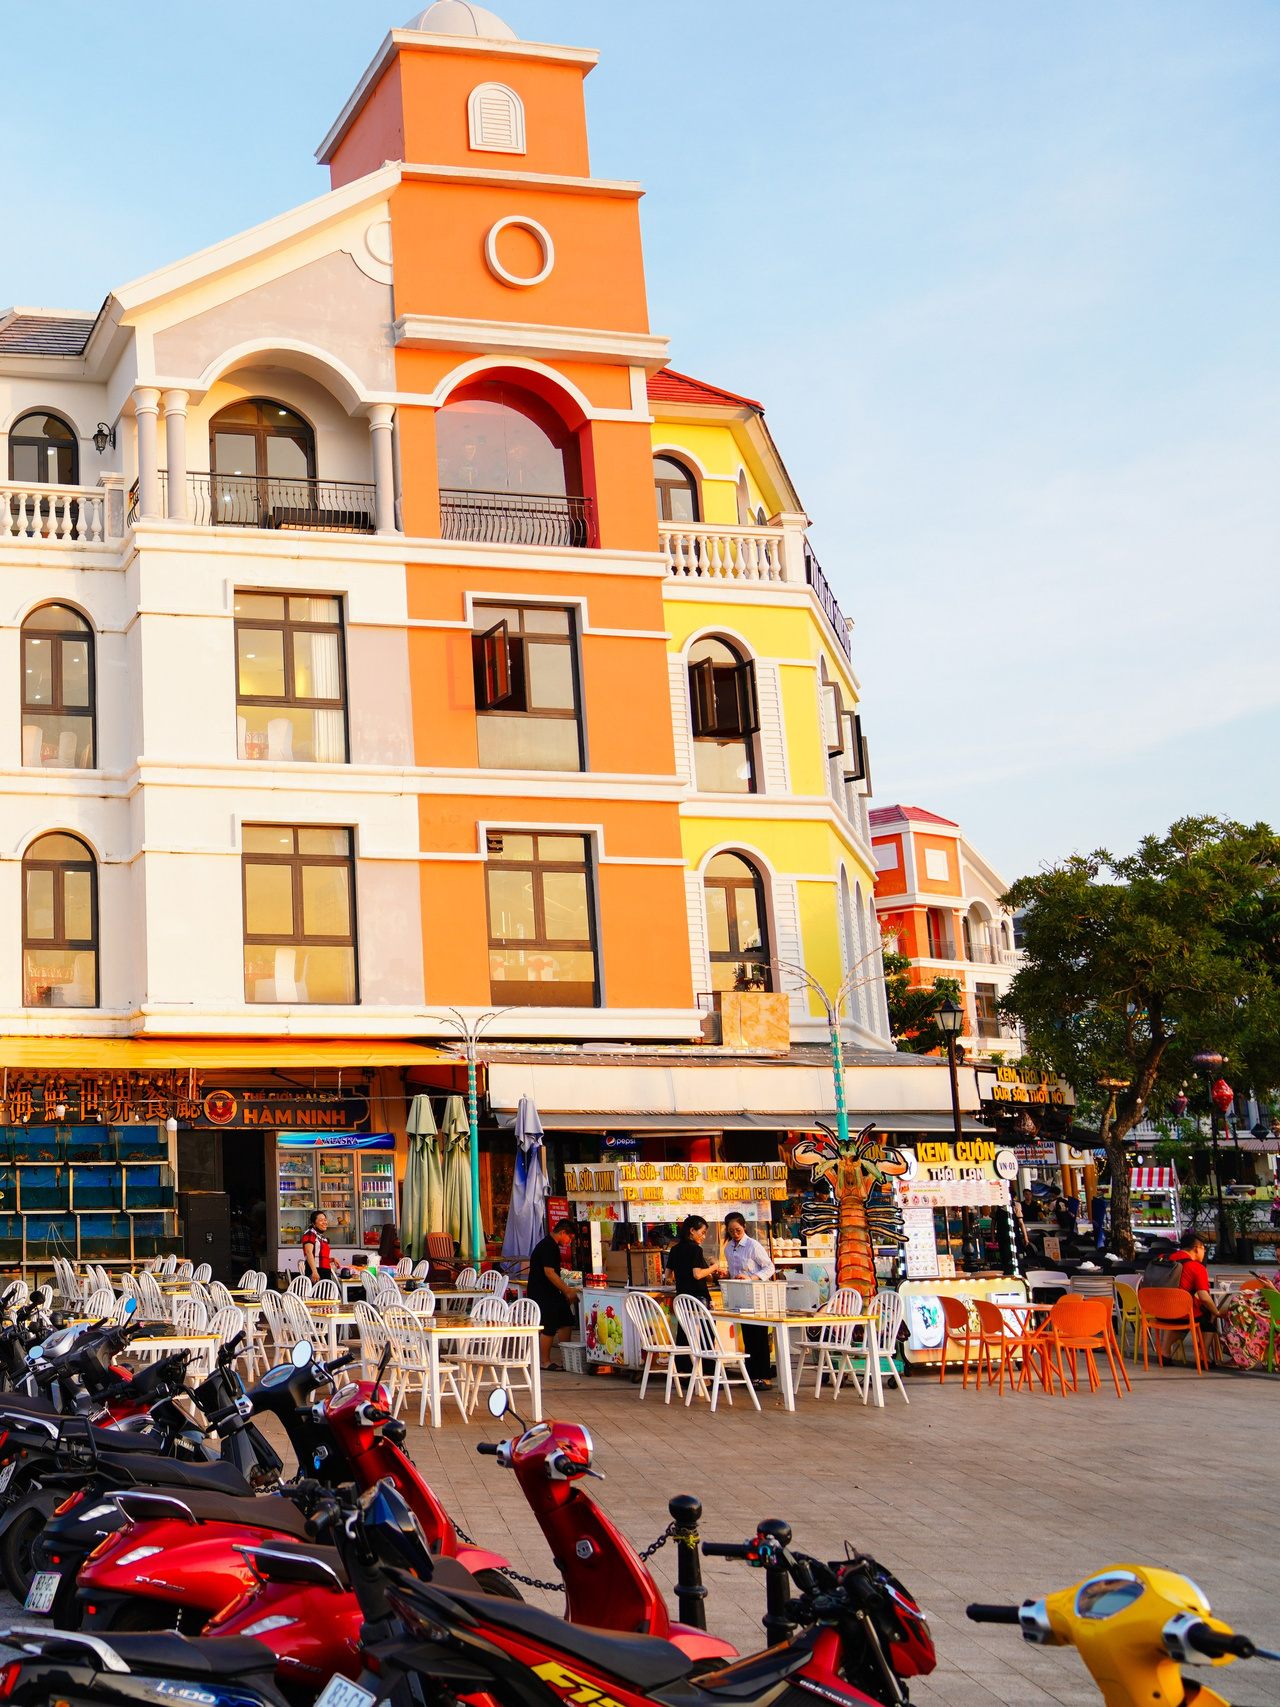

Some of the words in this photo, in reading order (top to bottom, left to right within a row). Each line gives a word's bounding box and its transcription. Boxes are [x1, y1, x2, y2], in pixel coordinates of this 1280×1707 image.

[997, 1067, 1017, 1083] KEM
[243, 1105, 293, 1125] HÀM
[297, 1109, 346, 1125] NINH
[323, 1137, 359, 1146] ALASKA
[616, 1138, 636, 1146] pepsi
[917, 1142, 950, 1162] KEM
[955, 1138, 996, 1164] CUỘN
[621, 1162, 636, 1181] TRÀ
[707, 1166, 726, 1182] KEM
[752, 1162, 769, 1181] THÁI
[773, 1166, 788, 1181] LAN
[929, 1165, 957, 1180] THÁI
[961, 1168, 986, 1180] LAN
[623, 1187, 639, 1200] TEA
[642, 1187, 664, 1200] MILK
[680, 1187, 704, 1200] JUICE
[722, 1187, 750, 1200] CREAM
[754, 1187, 767, 1200] ICE
[769, 1187, 789, 1200] ROLL
[156, 1681, 216, 1703] LUDO
